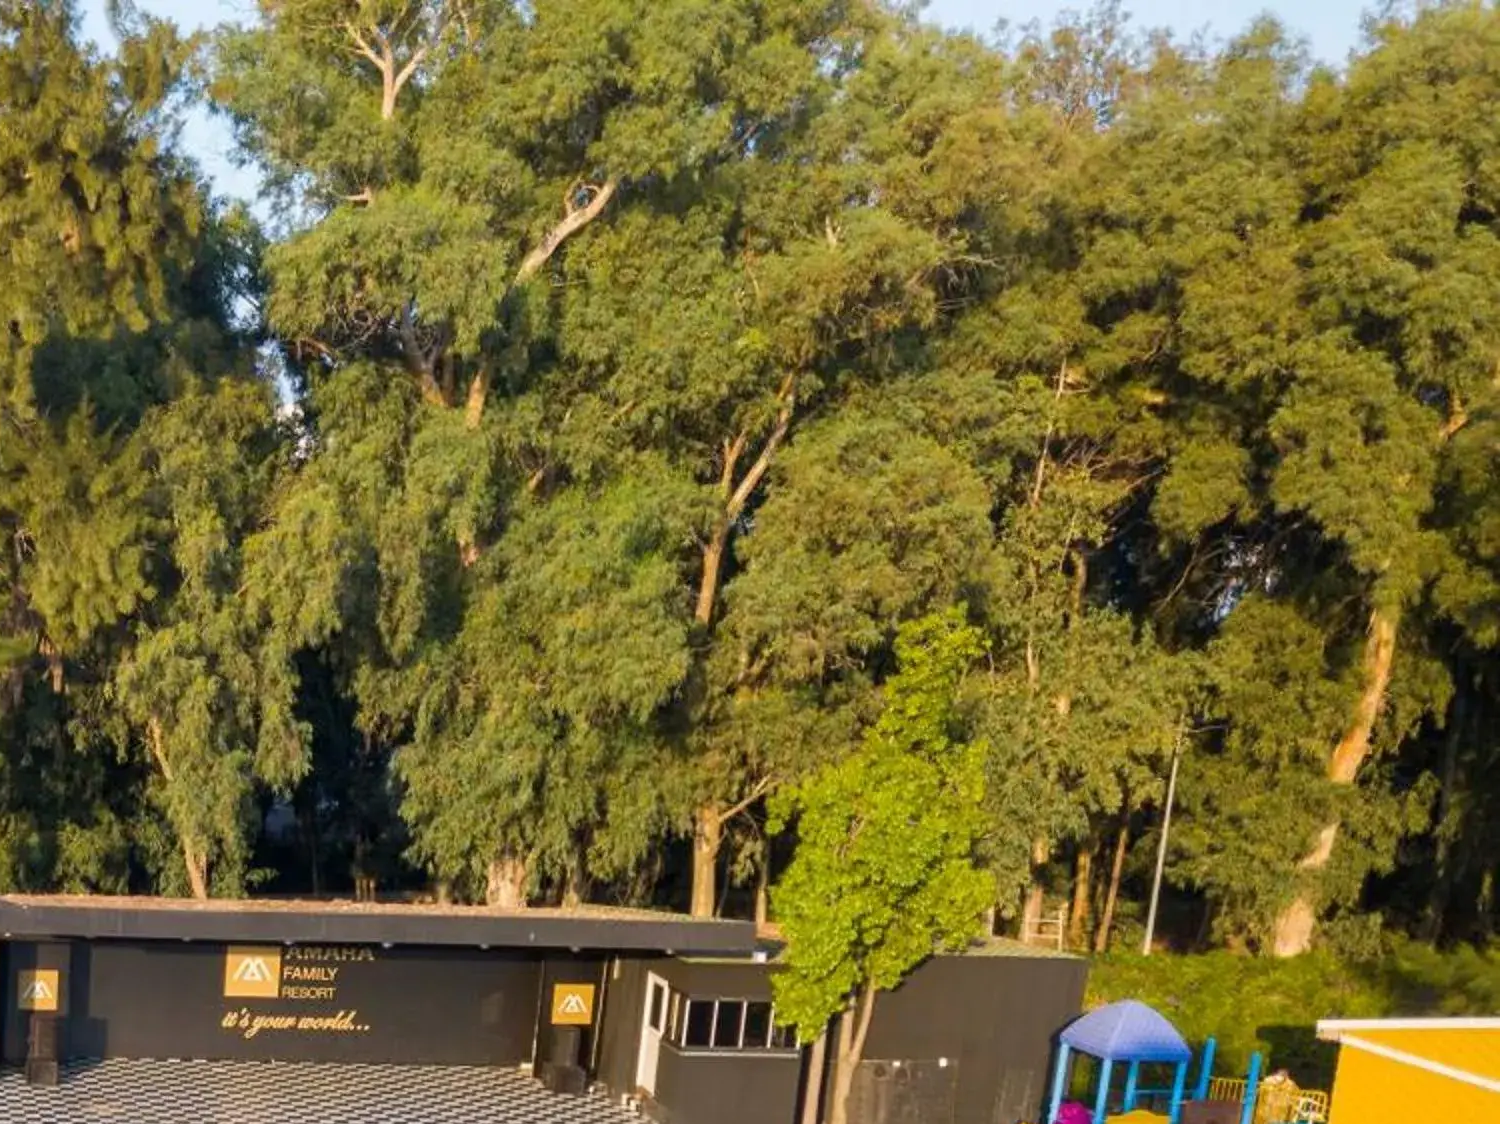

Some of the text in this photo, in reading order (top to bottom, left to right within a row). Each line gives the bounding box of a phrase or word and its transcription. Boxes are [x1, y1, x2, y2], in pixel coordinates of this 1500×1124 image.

[283, 966, 338, 981] FAMILY
[282, 986, 336, 1000] RESORT
[221, 1008, 250, 1028] it's
[244, 1015, 296, 1039] your
